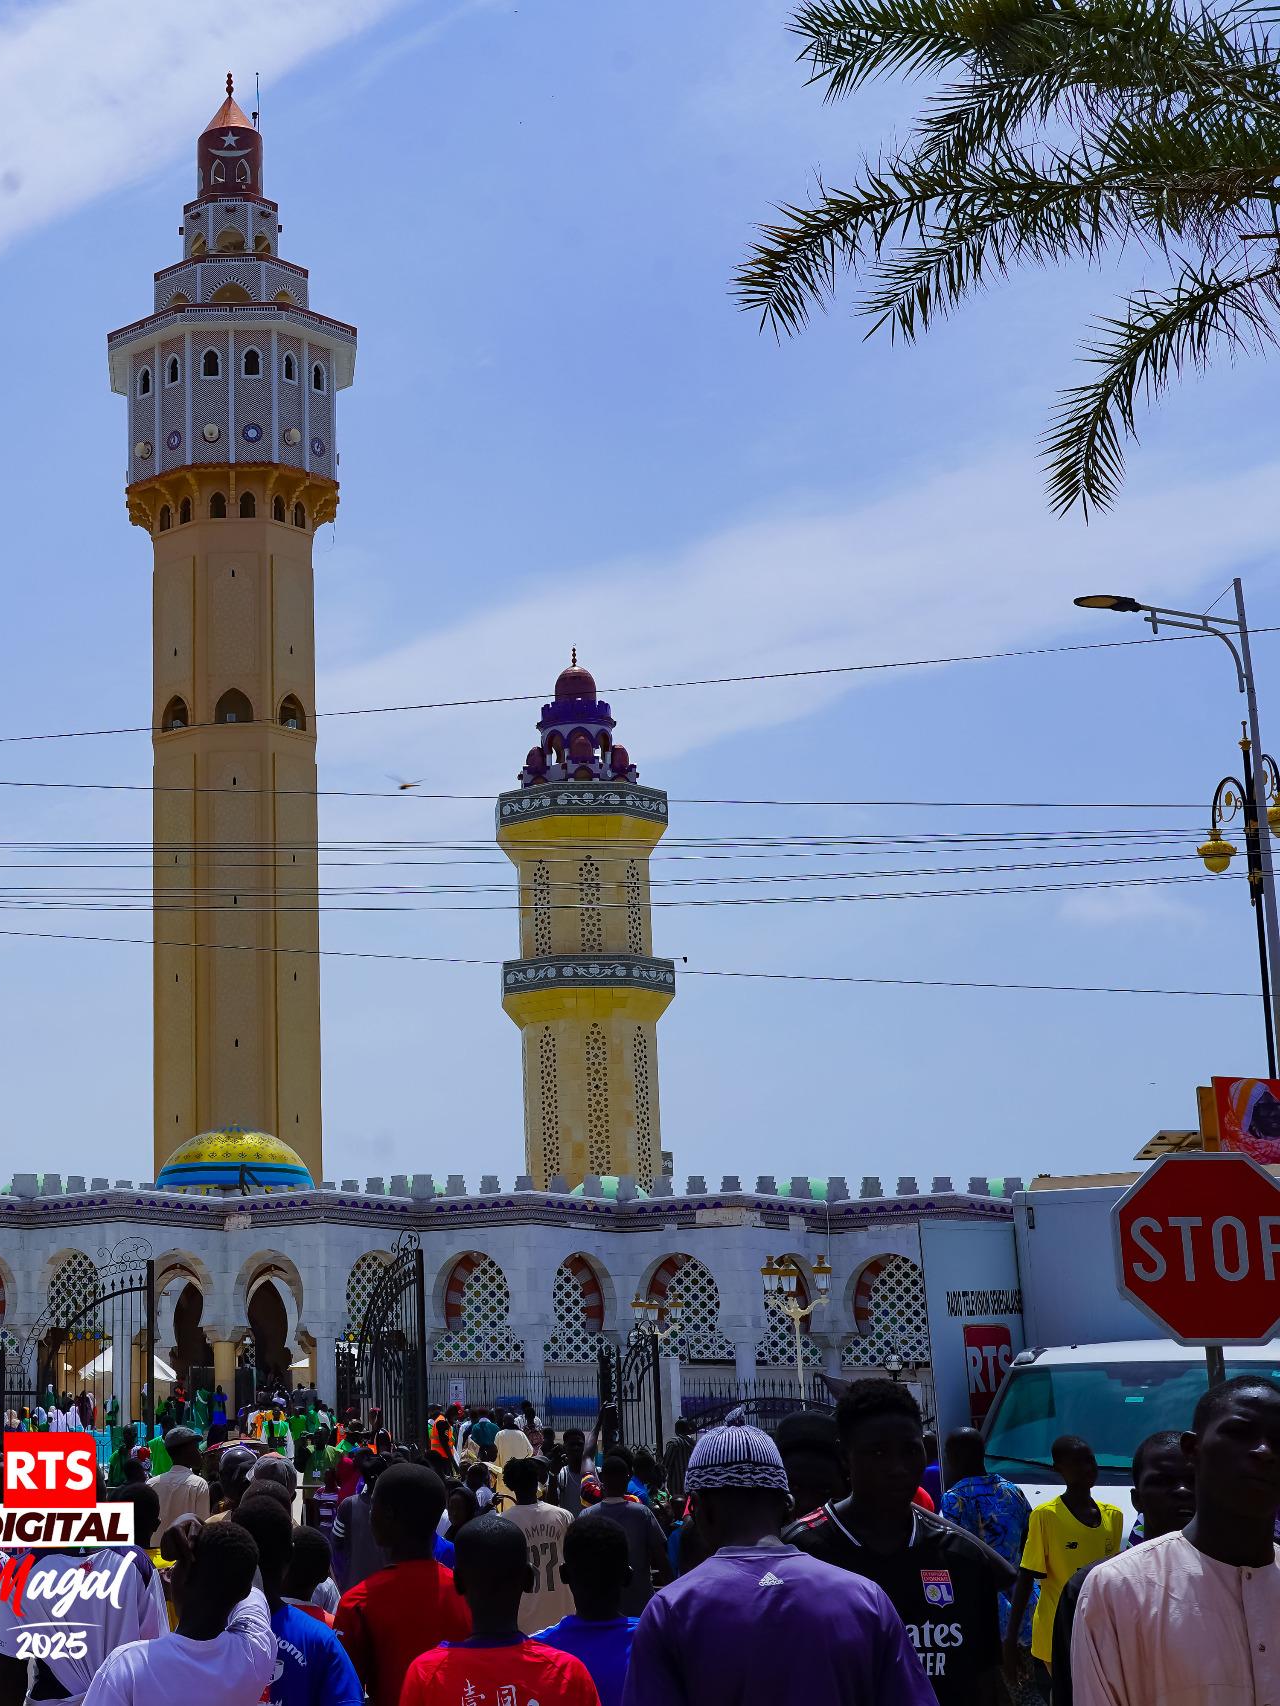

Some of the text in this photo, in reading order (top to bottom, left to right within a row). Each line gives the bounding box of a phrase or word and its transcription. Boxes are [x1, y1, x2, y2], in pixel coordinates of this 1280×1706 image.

[966, 1344, 1012, 1392] RTS
[524, 1523, 562, 1541] AMPION
[926, 1584, 952, 1601] OL
[905, 1620, 963, 1648] ates
[918, 1652, 946, 1676] TER
